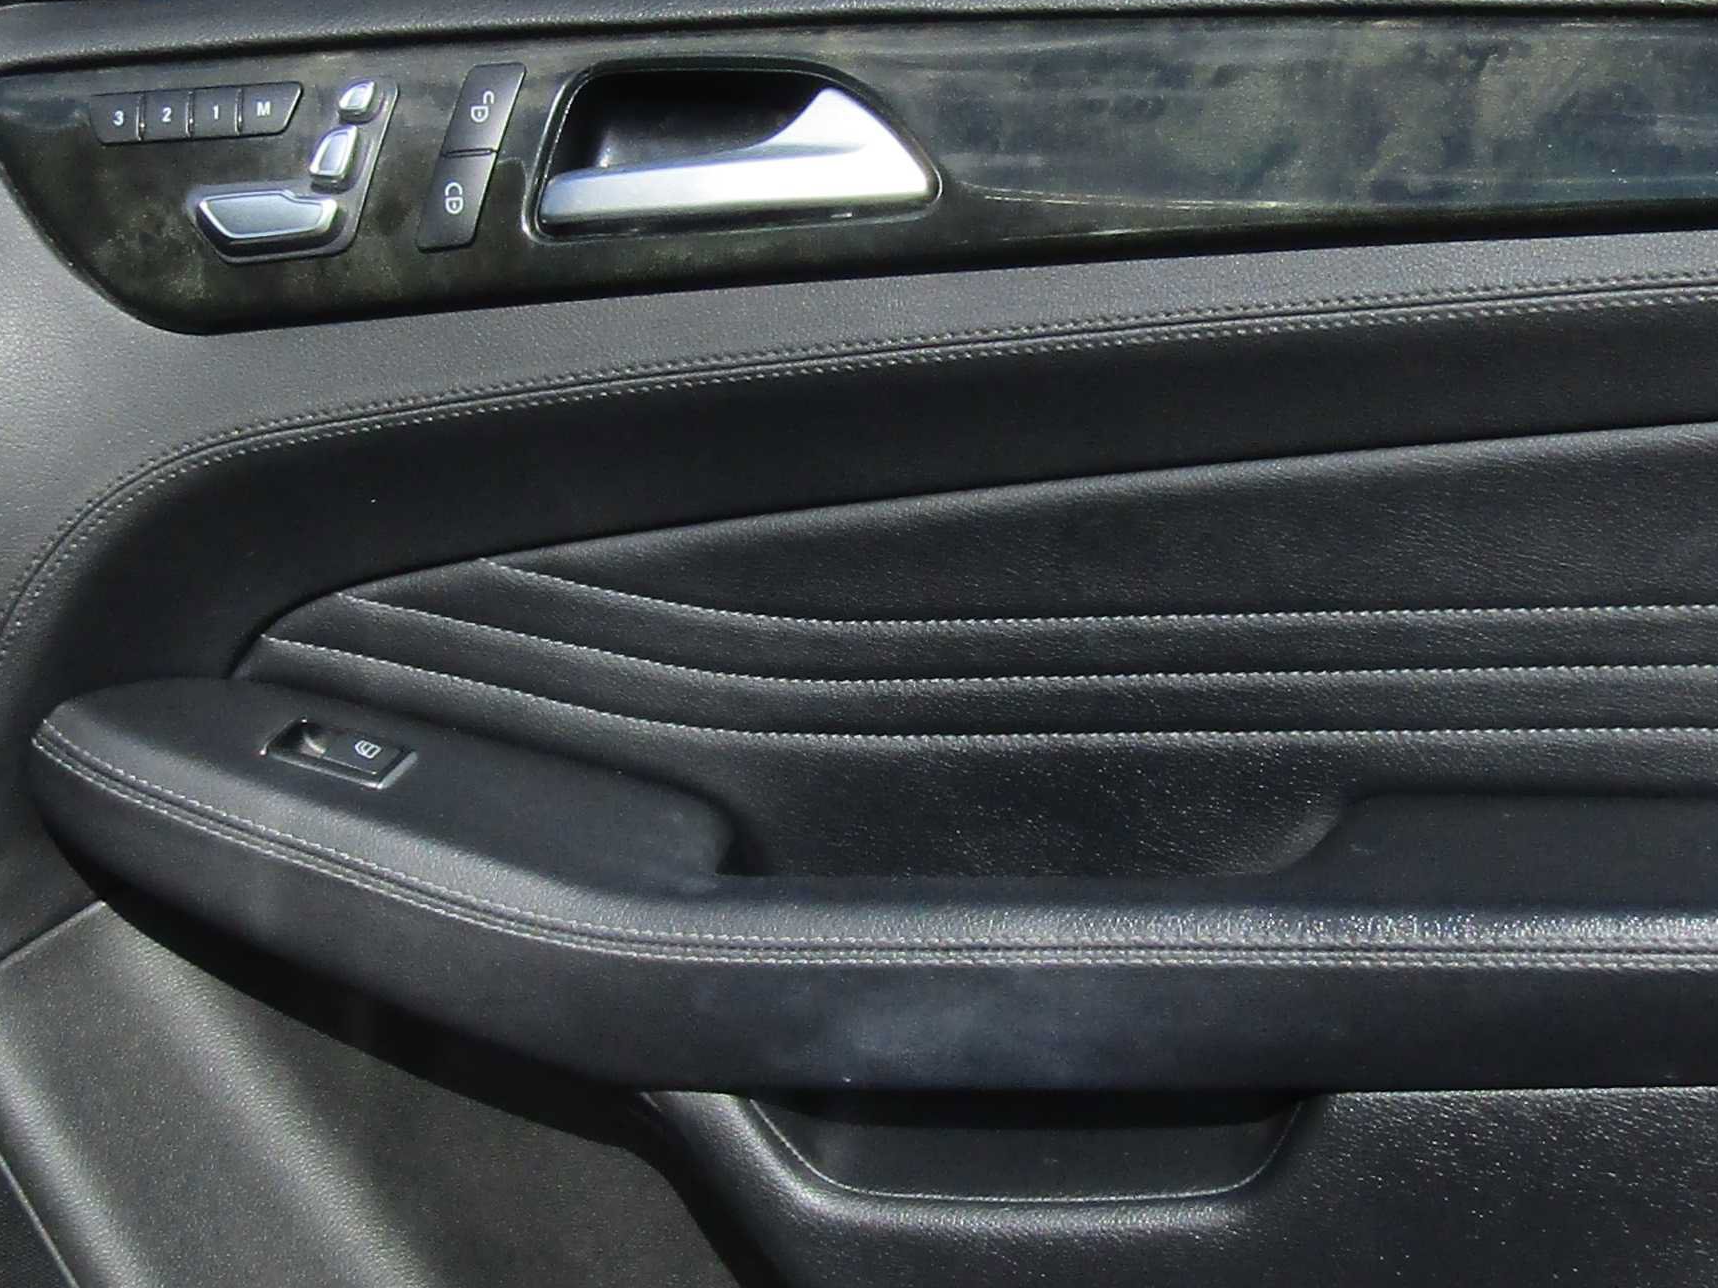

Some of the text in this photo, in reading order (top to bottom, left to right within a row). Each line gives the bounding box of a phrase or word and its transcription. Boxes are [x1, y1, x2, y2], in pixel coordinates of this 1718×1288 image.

[112, 101, 271, 126] 3 2 1 M
